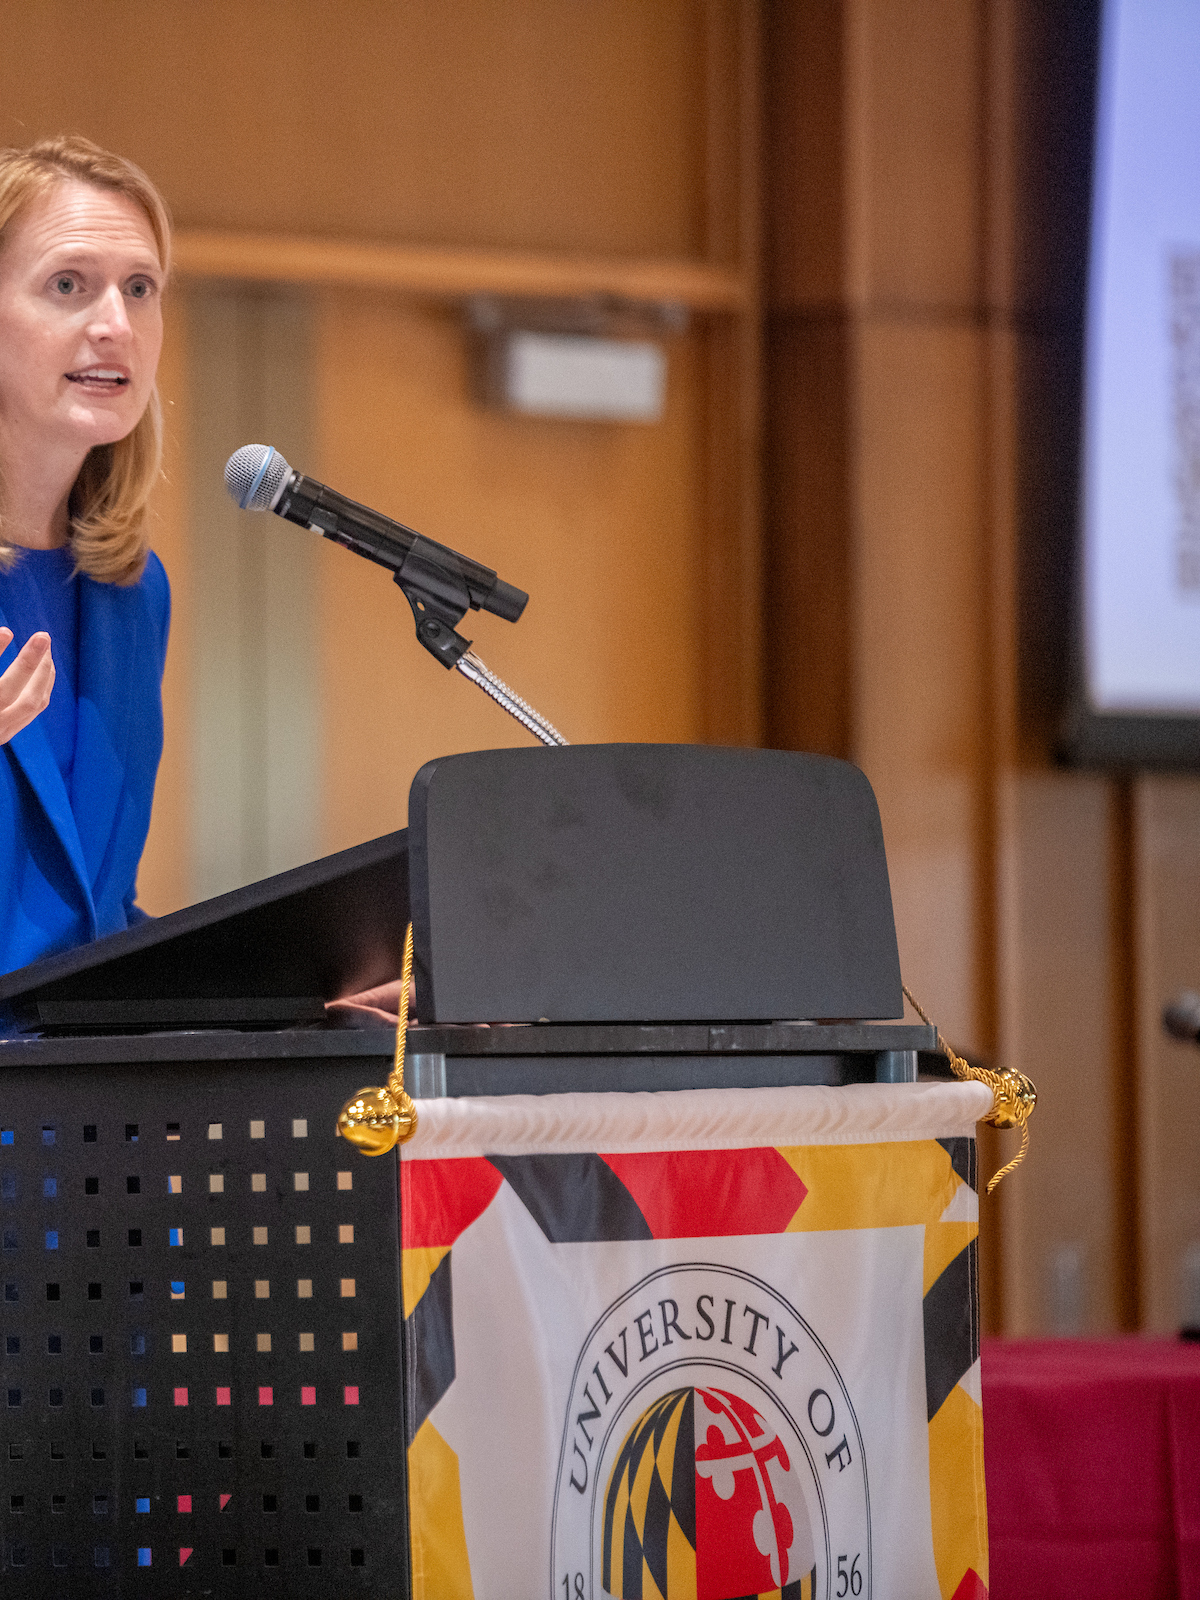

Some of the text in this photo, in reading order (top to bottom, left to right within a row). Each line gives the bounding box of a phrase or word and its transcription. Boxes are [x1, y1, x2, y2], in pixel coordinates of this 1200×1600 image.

[569, 1294, 853, 1495] UNIVERSITY OF
[562, 1553, 863, 1600] 18 56
